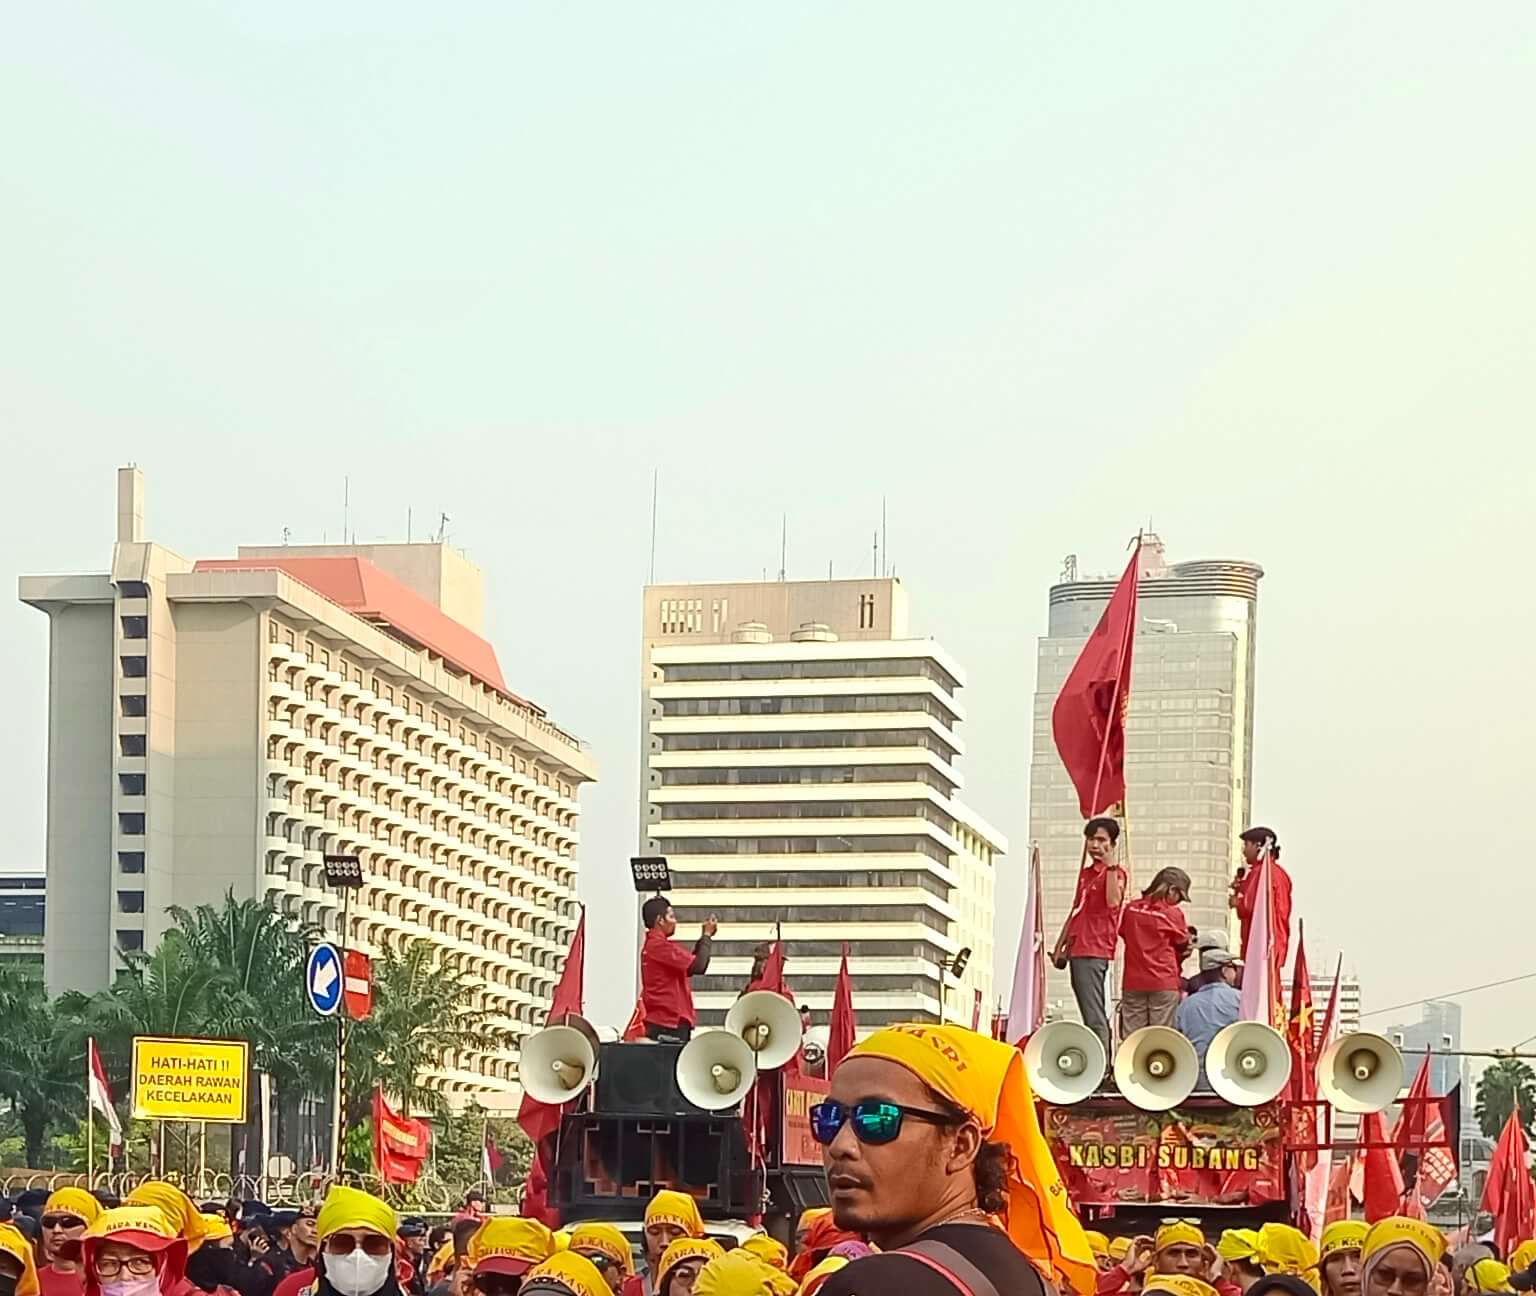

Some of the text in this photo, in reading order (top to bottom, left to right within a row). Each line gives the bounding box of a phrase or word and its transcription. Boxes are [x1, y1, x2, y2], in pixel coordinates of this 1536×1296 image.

[151, 1056, 218, 1072] HATI-HATI
[139, 1074, 241, 1089] DAERAH RAWAN
[146, 1090, 232, 1105] KECELAKAAN
[1069, 1145, 1260, 1171] KASBI SUBANG
